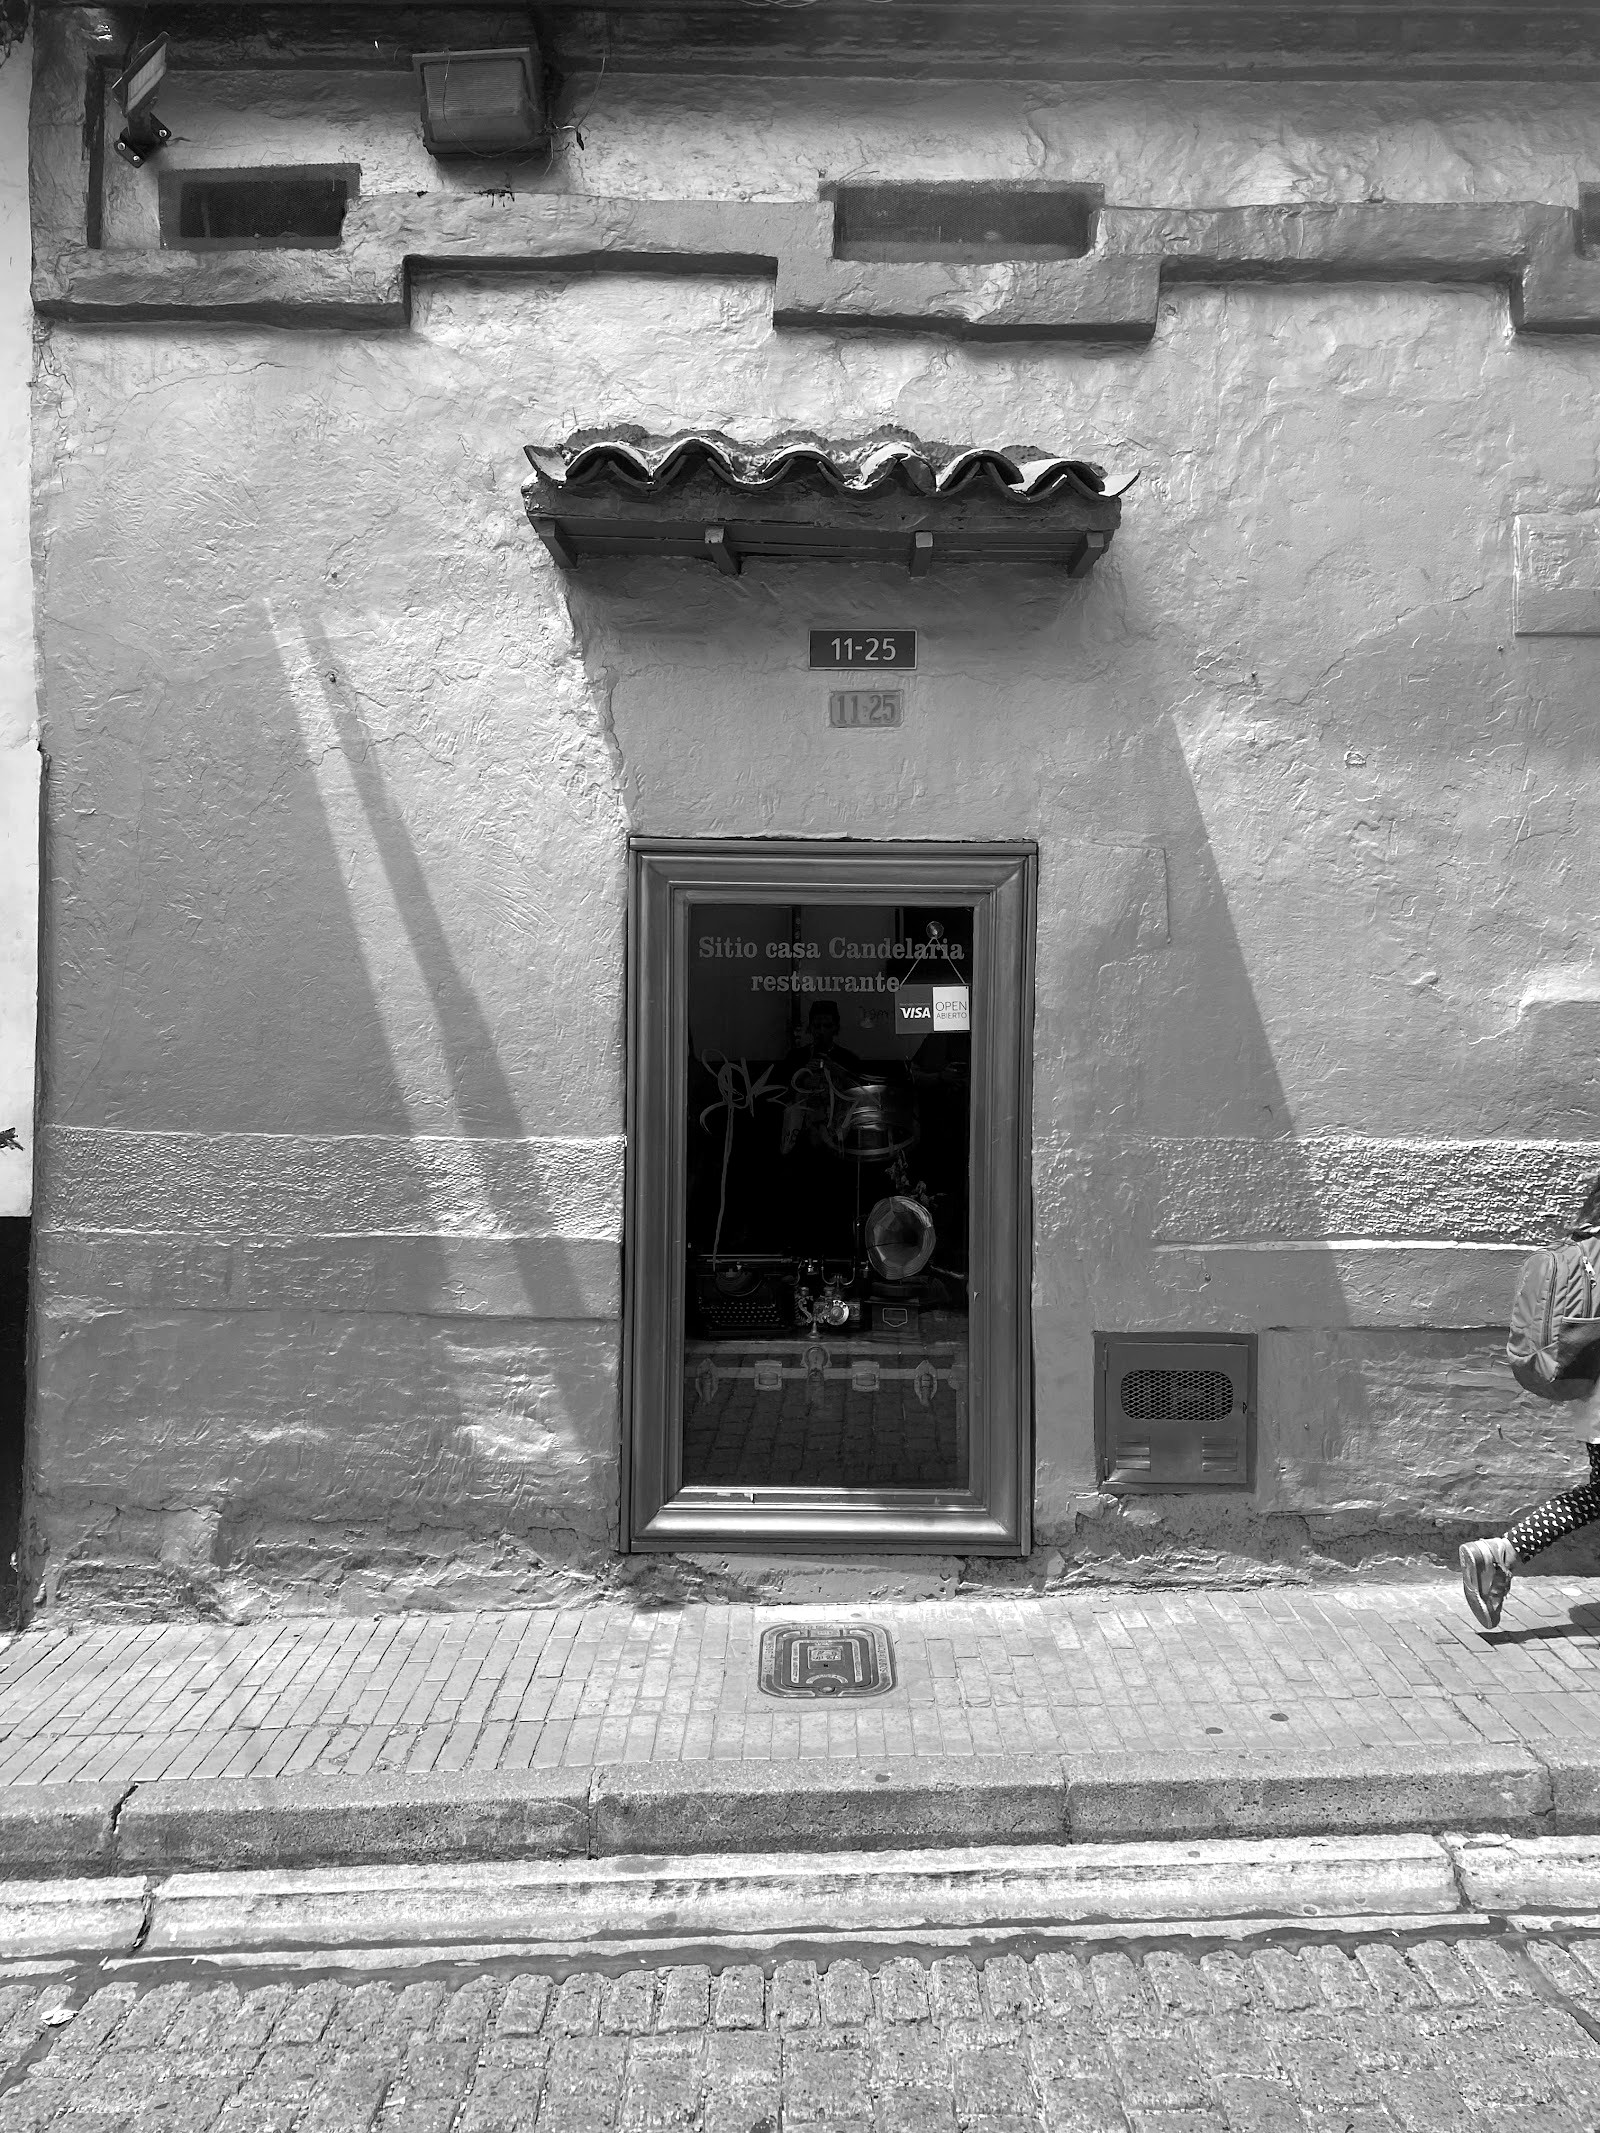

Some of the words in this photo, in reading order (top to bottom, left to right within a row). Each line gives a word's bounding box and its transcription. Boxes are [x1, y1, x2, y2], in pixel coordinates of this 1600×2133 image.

[831, 637, 896, 661] 11-25
[699, 936, 758, 959] Sitio
[765, 940, 821, 960] casa
[828, 936, 965, 960] Candelaria
[751, 970, 900, 993] restaurante
[900, 1007, 931, 1019] VISA
[935, 1000, 967, 1012] OPEN
